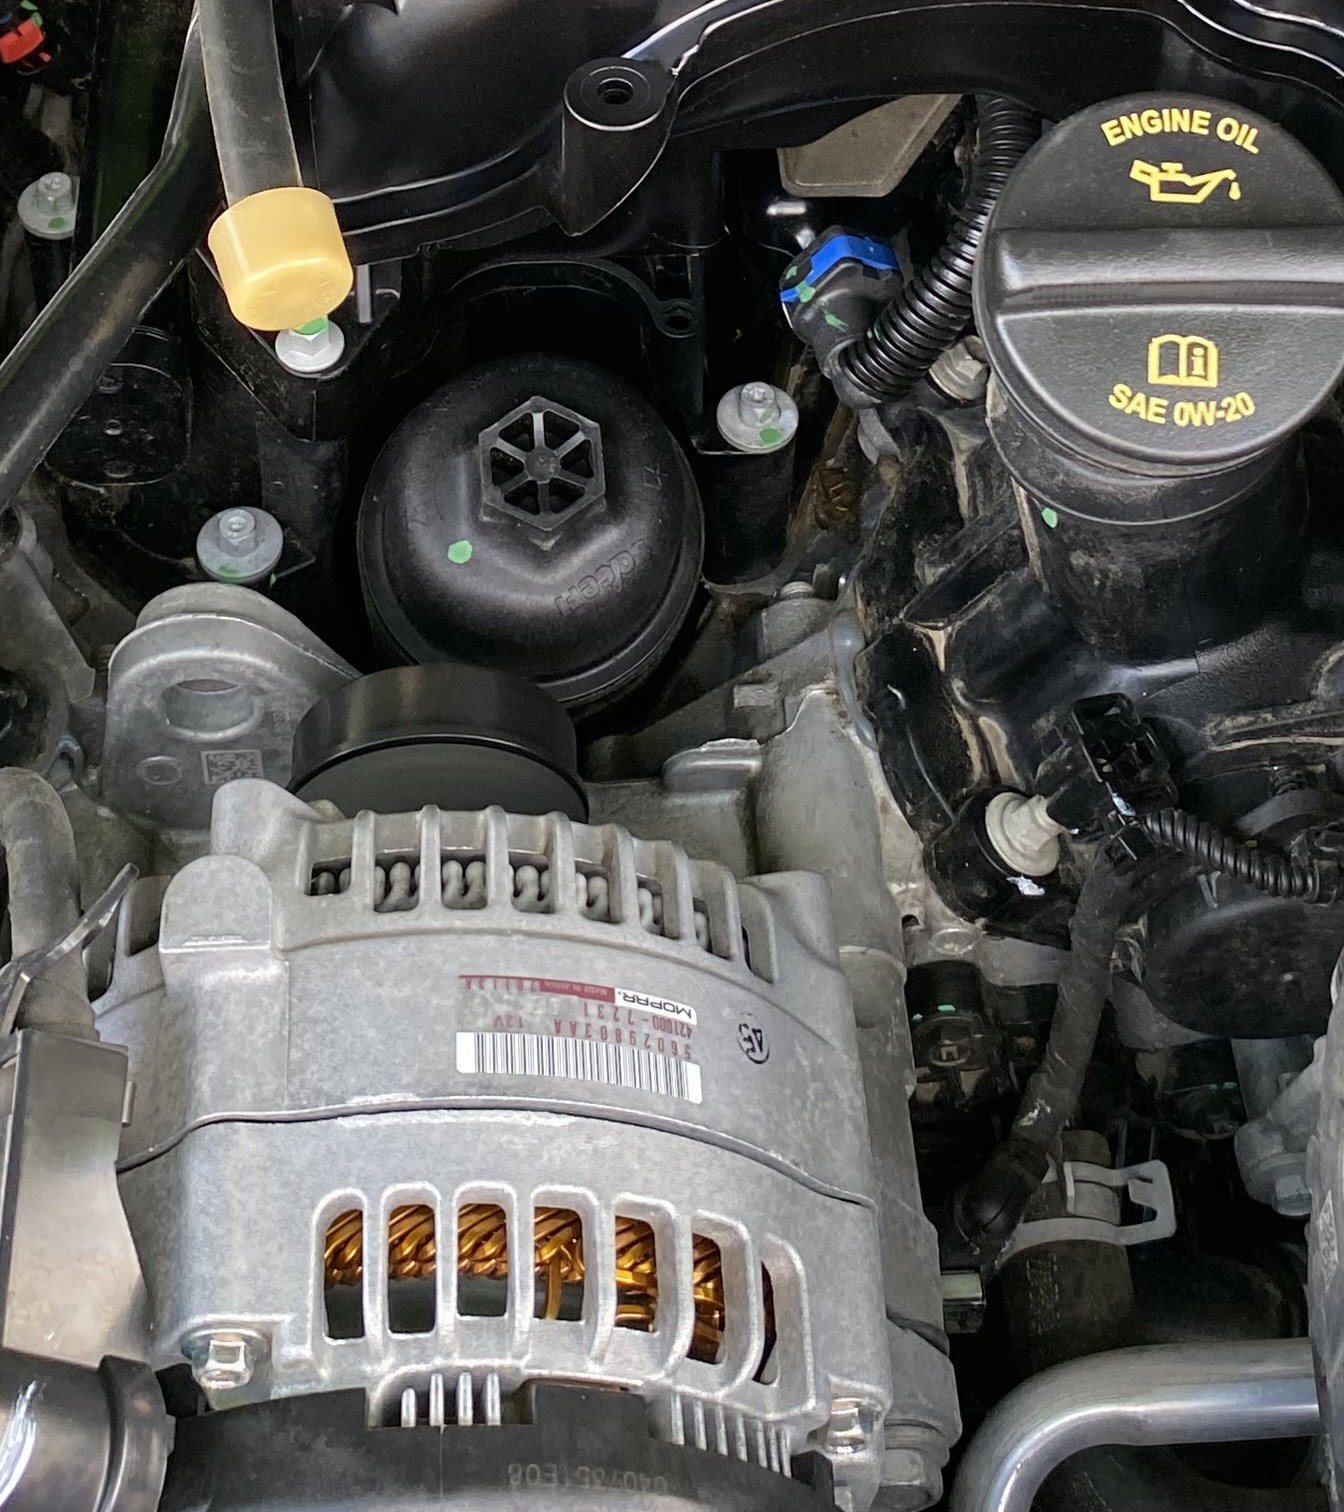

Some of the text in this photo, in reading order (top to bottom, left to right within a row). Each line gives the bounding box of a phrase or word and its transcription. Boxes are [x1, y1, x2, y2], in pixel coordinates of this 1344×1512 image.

[1100, 108, 1260, 155] ENGINE OIL
[1108, 382, 1256, 427] SAE 0W-20
[554, 1019, 692, 1060] 56029803AA
